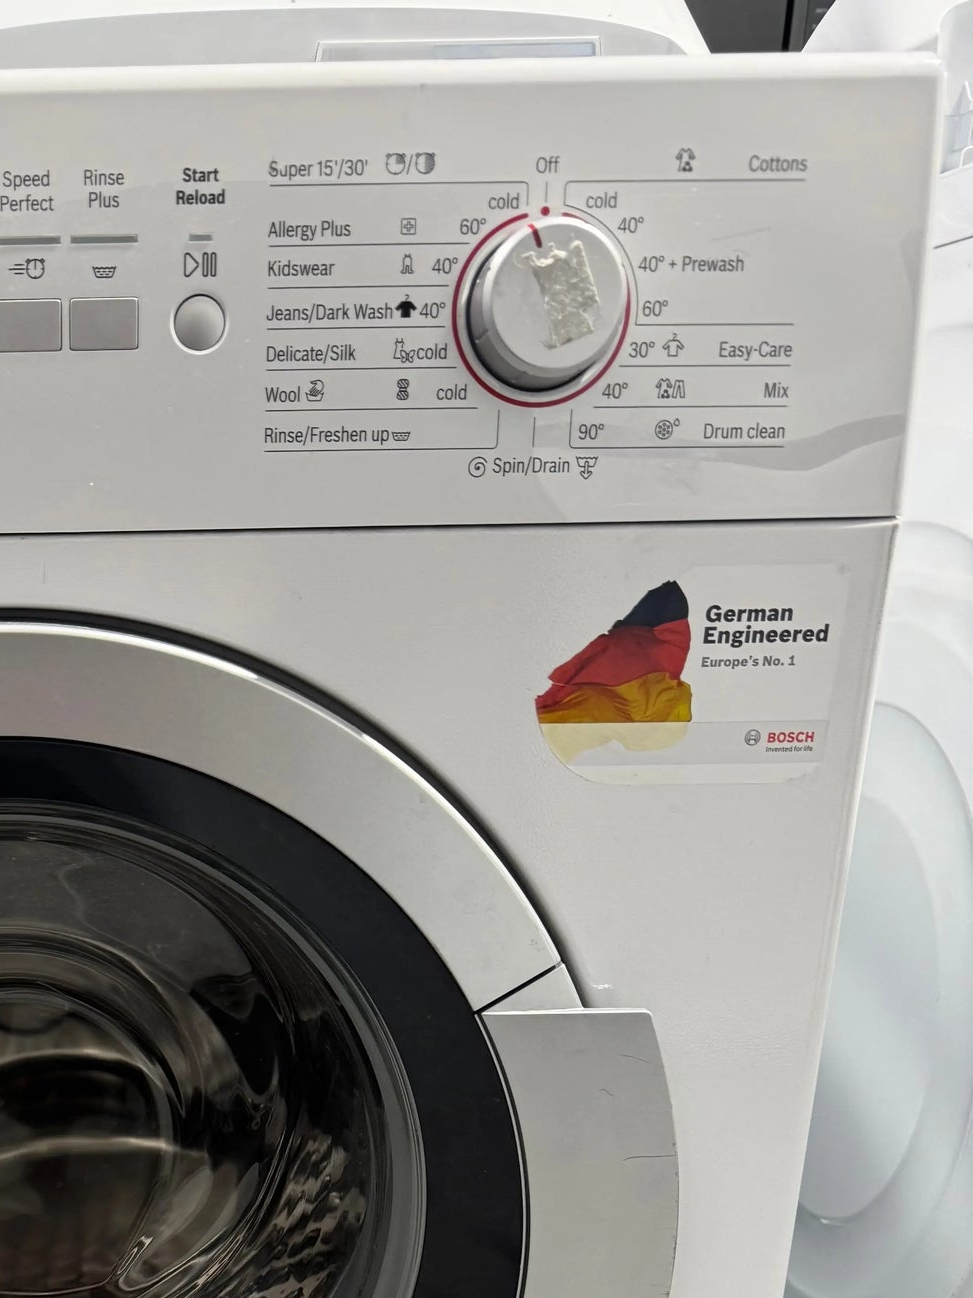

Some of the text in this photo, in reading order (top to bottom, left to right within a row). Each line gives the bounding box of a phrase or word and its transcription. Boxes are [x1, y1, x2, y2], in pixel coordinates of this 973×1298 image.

[268, 158, 368, 181] Super 15'/30'
[535, 156, 561, 174] Off
[748, 154, 808, 173] Cottons
[2, 169, 51, 191] Speed
[83, 169, 125, 186] Rinse
[182, 167, 220, 182] Start
[0, 194, 55, 213] Perfect
[88, 191, 120, 208] Plus
[176, 188, 226, 206] Reload
[488, 192, 520, 211] cold
[585, 192, 618, 209] cold
[267, 219, 351, 241] Allergy Plus
[460, 217, 487, 236] 60°
[617, 216, 644, 234] 40°
[267, 260, 335, 277] Kidswear
[432, 257, 458, 275] 40°
[638, 255, 664, 273] 40°
[682, 255, 745, 273] Prewash
[266, 301, 393, 324] Jeans/Dark Wash
[419, 301, 446, 319] 40°
[642, 299, 668, 318] 60°
[266, 344, 357, 364] Delicate/Silk
[416, 342, 448, 361] cold
[628, 341, 656, 359] 30°
[719, 341, 793, 361] Easy-Care
[265, 385, 301, 403] Wool
[436, 383, 468, 401] cold
[601, 382, 628, 400] 40°
[763, 381, 790, 399] Mix
[263, 426, 390, 446] Rinse/Freshen up
[578, 423, 605, 441] 90°
[703, 421, 786, 441] Drum clean
[492, 455, 570, 477] Spin/Drain
[705, 604, 794, 623] German
[702, 623, 830, 648] Engineered
[762, 655, 785, 667] No.
[788, 655, 796, 667] 1
[766, 731, 815, 744] BOSCH
[765, 745, 793, 753] Invented
